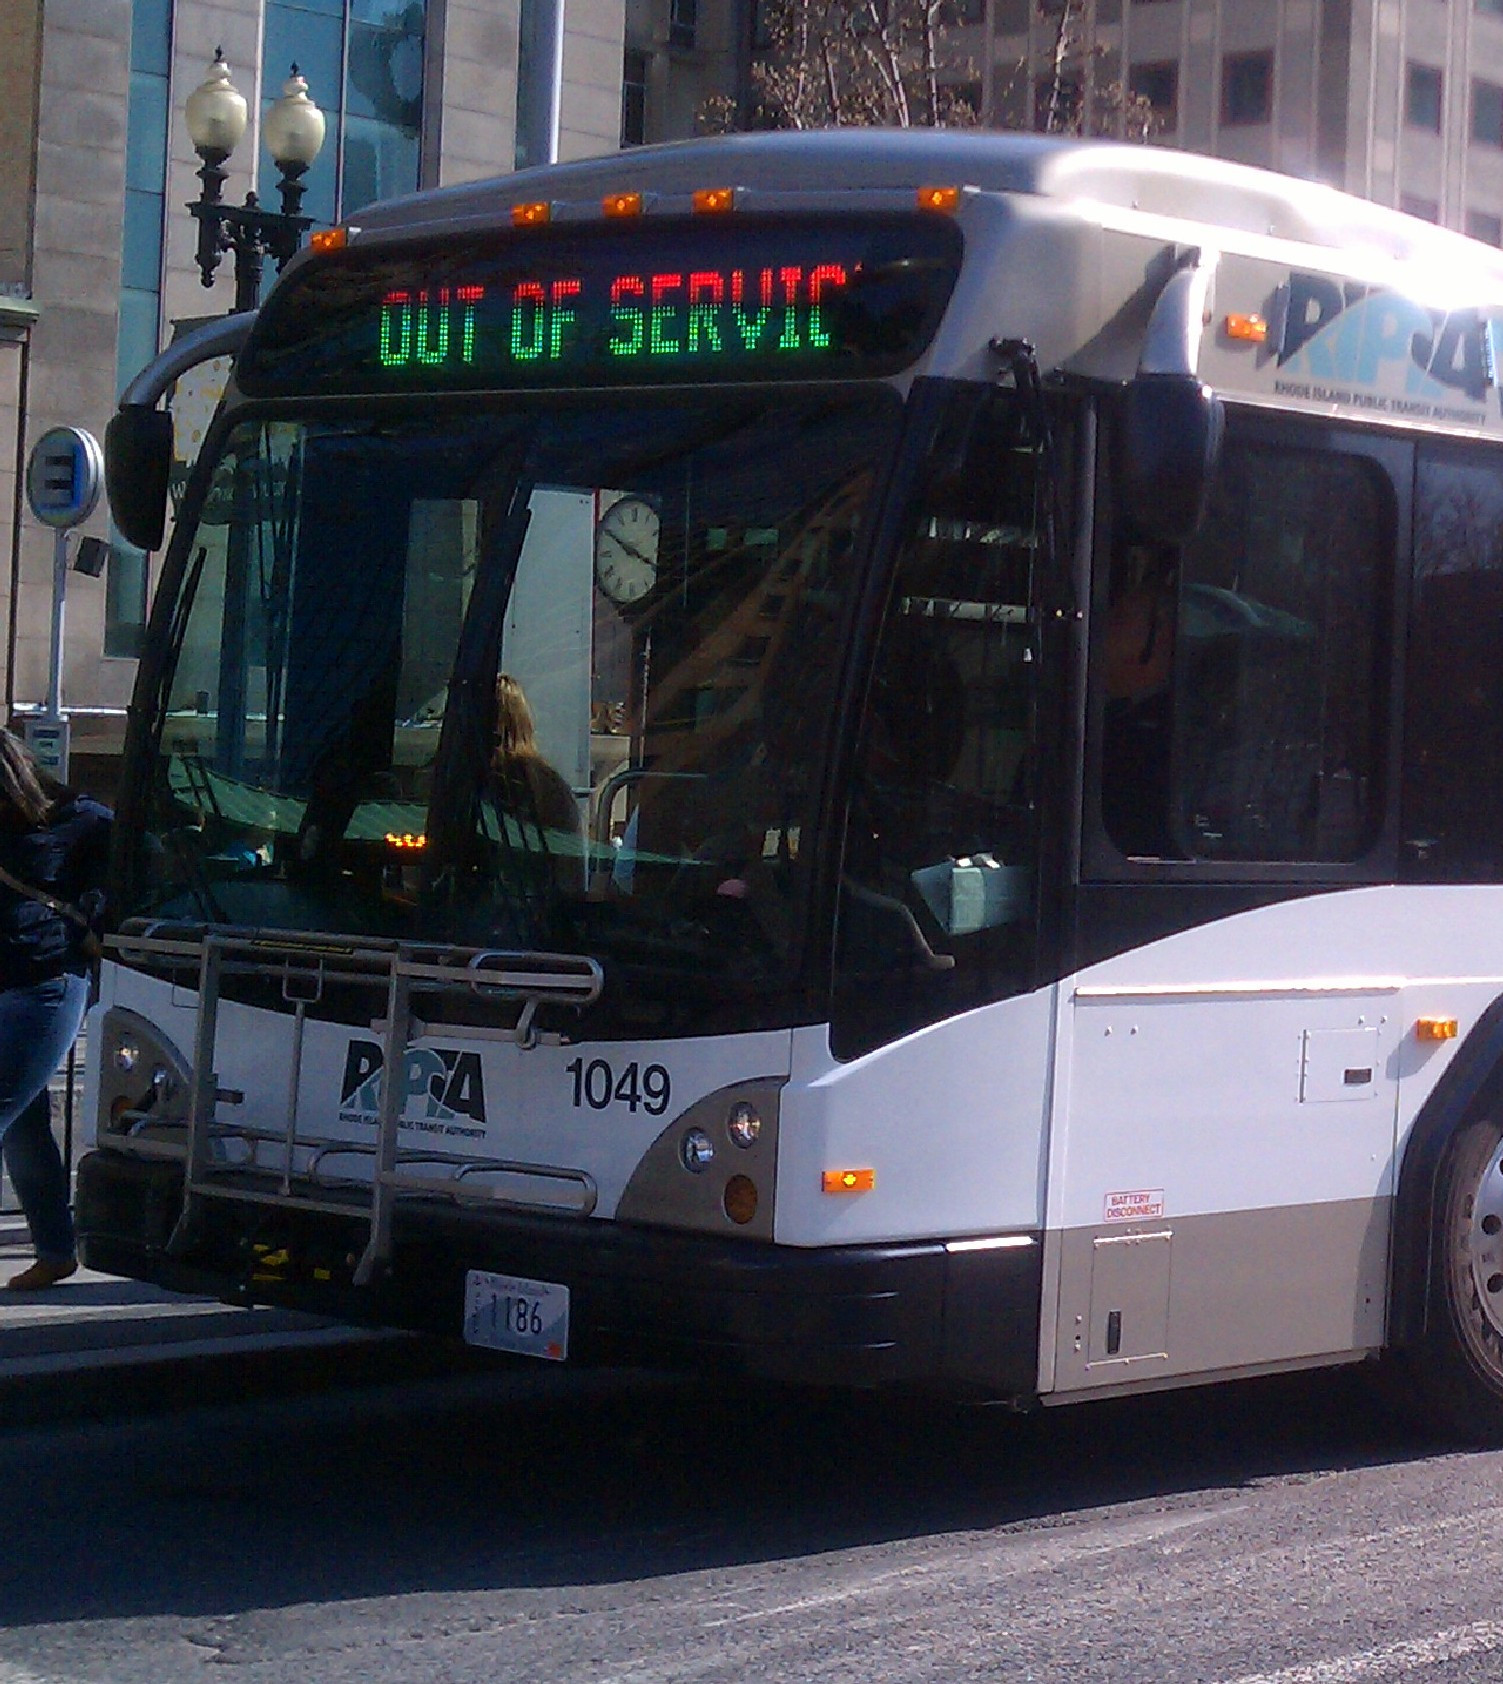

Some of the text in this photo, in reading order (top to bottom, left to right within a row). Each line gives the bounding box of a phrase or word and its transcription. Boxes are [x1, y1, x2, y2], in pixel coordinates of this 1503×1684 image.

[379, 261, 848, 366] OUT OF SERVIC
[1275, 380, 1487, 426] RHODE ISLAND PUBLIC TRANSIT AUTHORITY
[340, 1039, 487, 1125] RPTA
[566, 1057, 671, 1116] 1049
[338, 1112, 362, 1124] RHODE
[415, 1121, 444, 1134] TRANSIT
[445, 1126, 486, 1139] AUTHORITY
[1107, 1203, 1162, 1218] DISCONNECT
[1111, 1194, 1151, 1206] BATTERY
[491, 1292, 543, 1335] 1186
